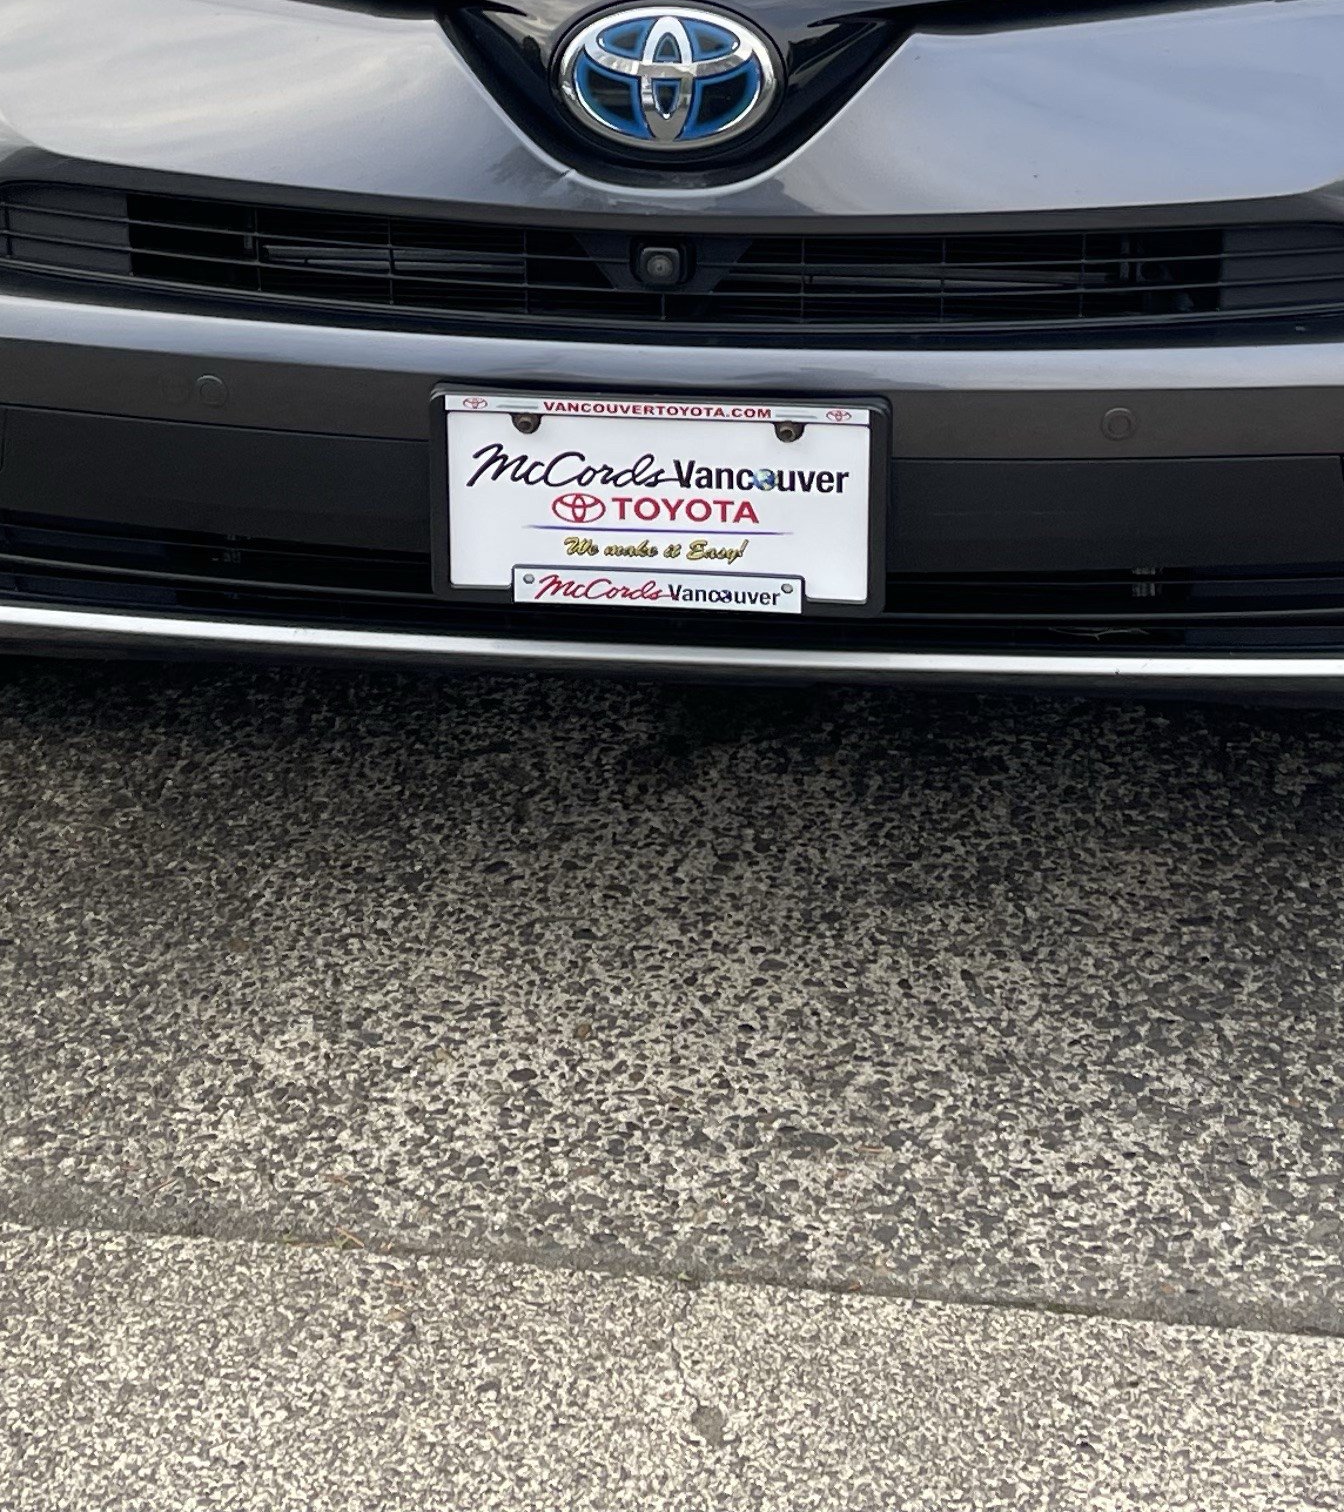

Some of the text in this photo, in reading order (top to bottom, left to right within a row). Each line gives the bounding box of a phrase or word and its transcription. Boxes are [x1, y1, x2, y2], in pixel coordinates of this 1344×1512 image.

[543, 400, 772, 419] VANCOUVERTOYOTA.COM
[466, 443, 849, 493] McCords Vancouver
[612, 497, 759, 524] TOYOTA
[564, 536, 749, 565] We make it Easy!
[535, 574, 780, 605] McCords Vancouver
